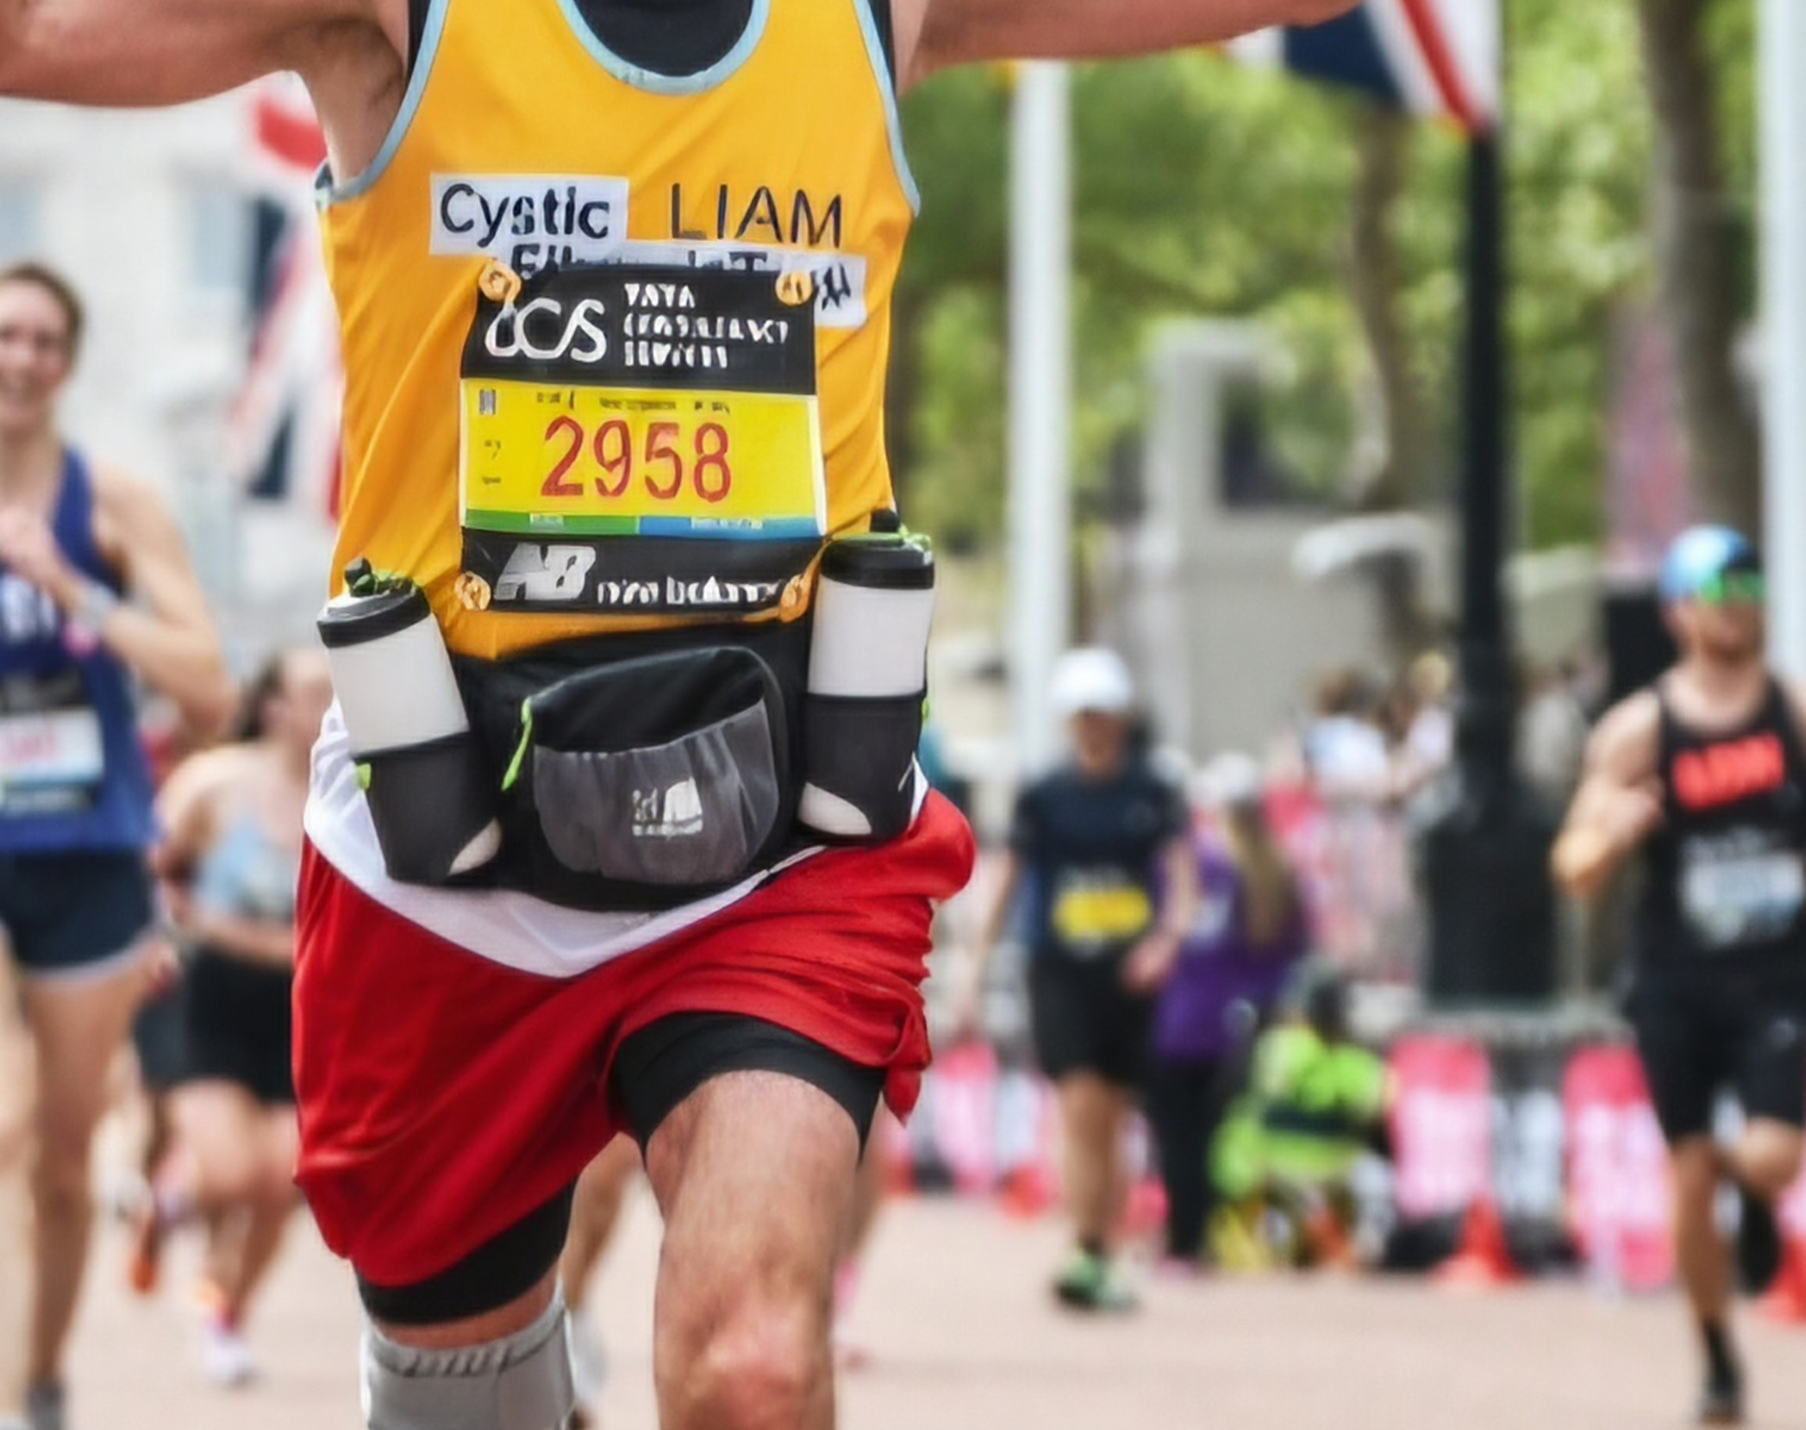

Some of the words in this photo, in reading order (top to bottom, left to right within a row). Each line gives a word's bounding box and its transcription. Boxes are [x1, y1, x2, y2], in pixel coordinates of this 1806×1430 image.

[440, 182, 610, 248] Cystic
[670, 182, 843, 249] LIAM
[540, 414, 733, 504] 2958
